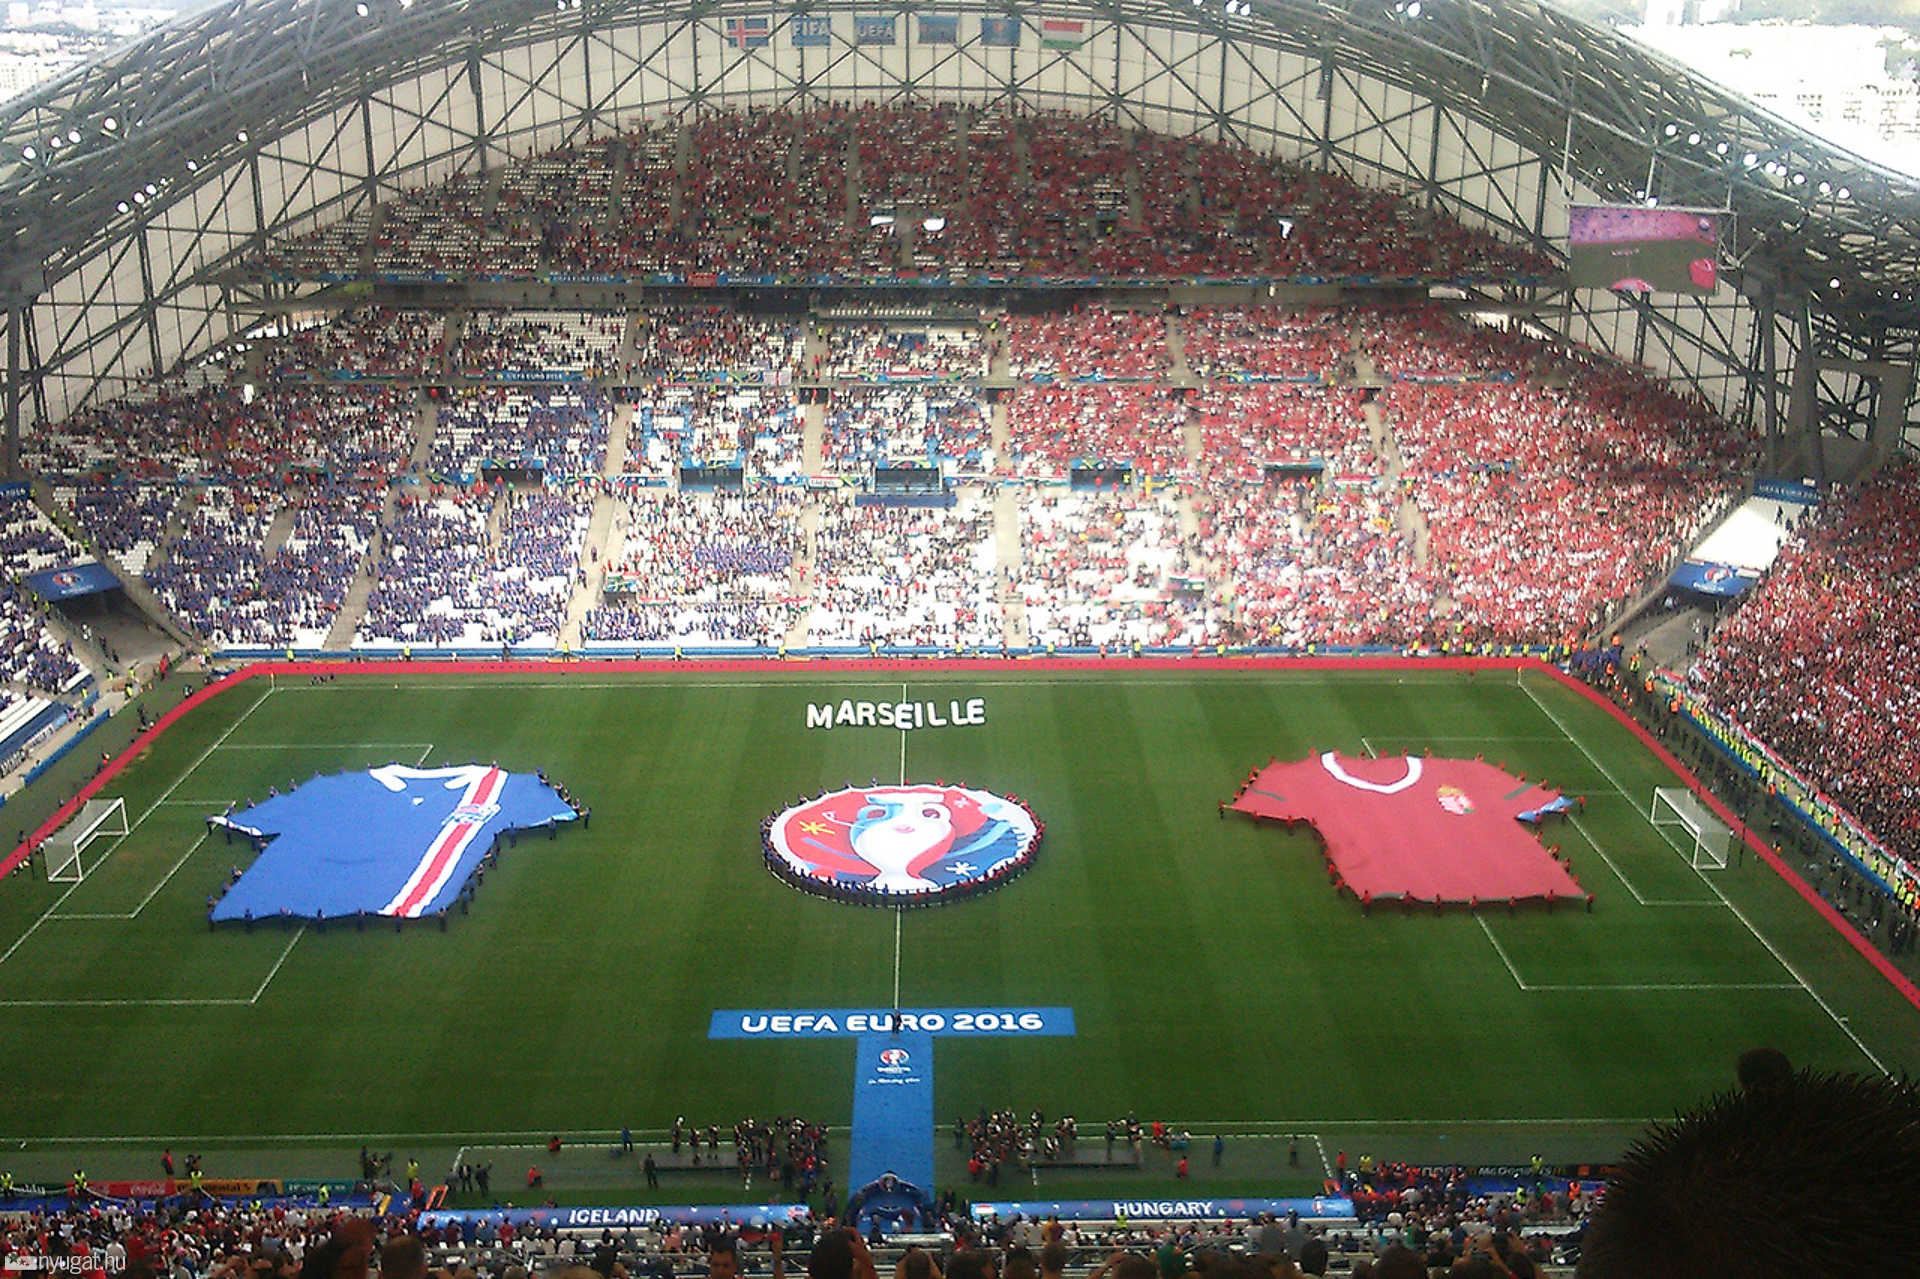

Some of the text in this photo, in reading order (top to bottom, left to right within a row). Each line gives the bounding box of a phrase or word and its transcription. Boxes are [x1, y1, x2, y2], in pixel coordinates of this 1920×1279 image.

[792, 20, 829, 36] FIFA
[859, 25, 894, 38] UEFA
[806, 698, 986, 729] MARSEILLE
[741, 1013, 1044, 1033] UEFA EURO 2016
[569, 1208, 660, 1225] ICELAND
[1113, 1201, 1212, 1216] HUNGARY
